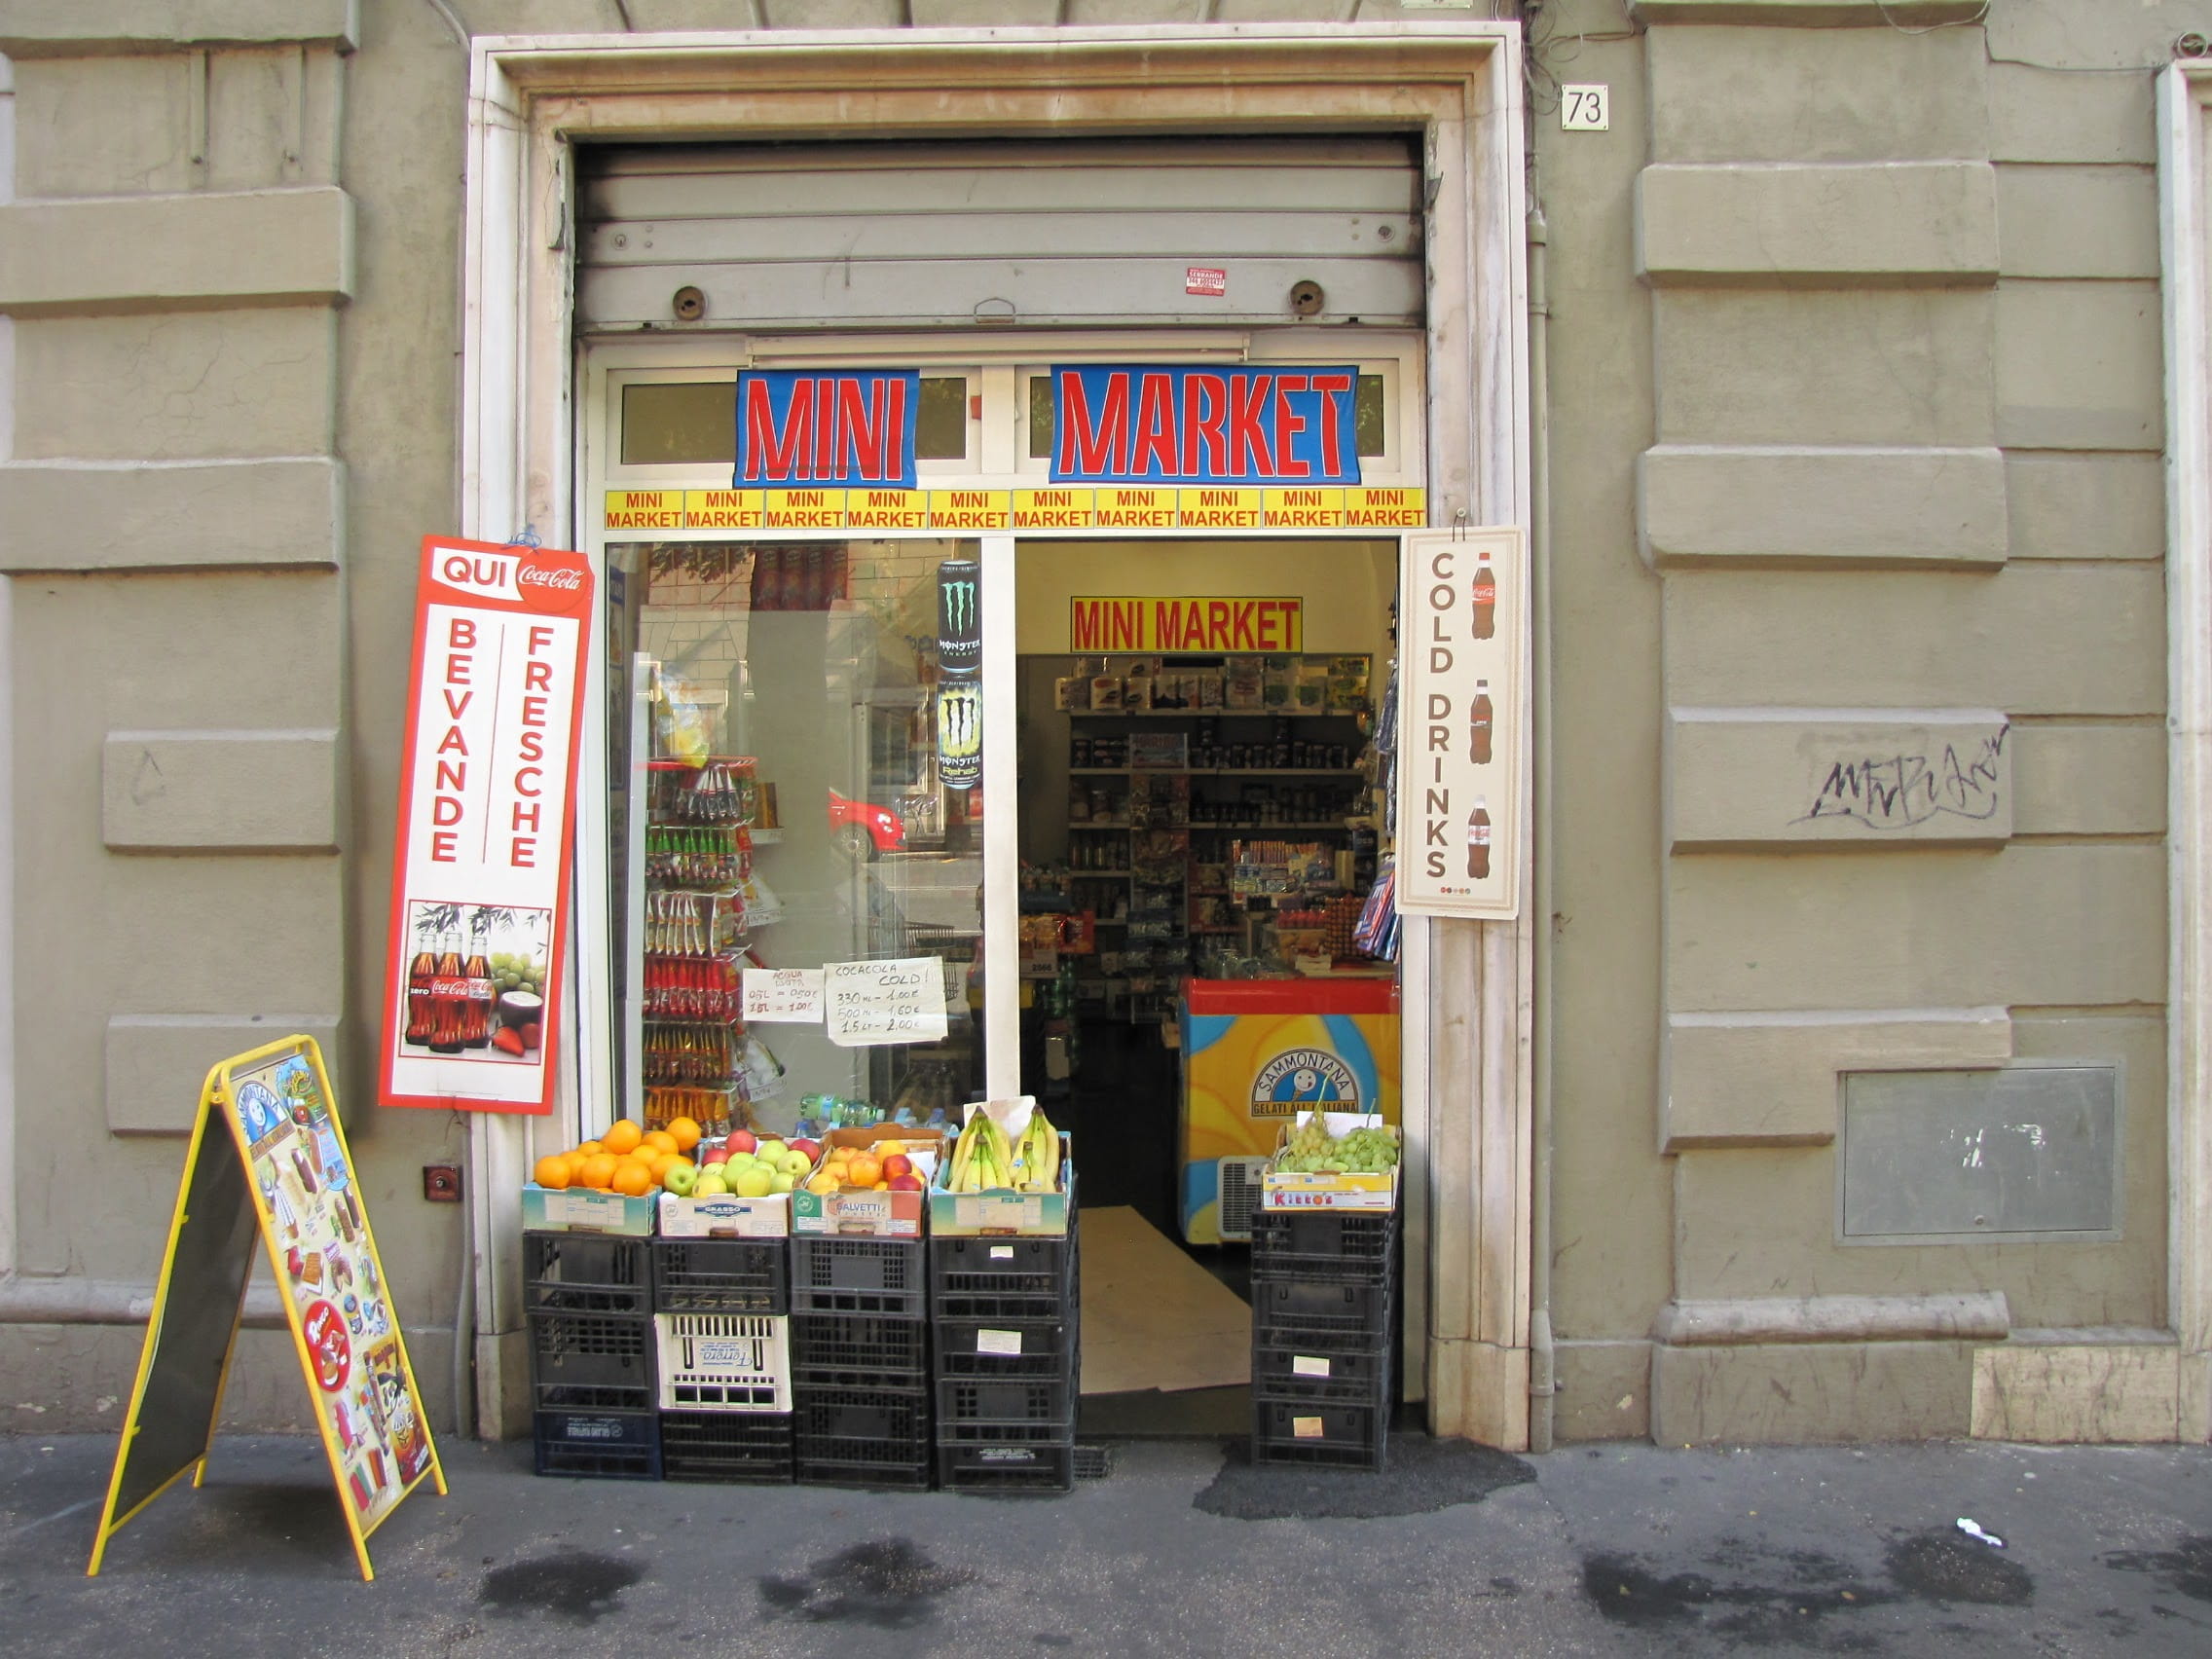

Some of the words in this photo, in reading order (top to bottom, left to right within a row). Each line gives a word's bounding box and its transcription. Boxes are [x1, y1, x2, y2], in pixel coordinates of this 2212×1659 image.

[1568, 92, 1601, 123] 73
[744, 378, 906, 482] MINI
[1057, 371, 1350, 478] MARKET
[626, 492, 662, 507] MINI
[706, 491, 743, 507] MINI
[787, 491, 825, 507] MINI
[867, 492, 906, 507] MINI
[950, 492, 989, 507] MINI
[1034, 490, 1072, 506] MINI
[1117, 490, 1155, 506] MINI
[1199, 490, 1238, 506] MINI
[1283, 490, 1322, 506] MINI
[1365, 490, 1404, 506] MINI
[607, 511, 682, 528] MARKET
[686, 510, 762, 527] MARKET
[766, 510, 844, 527] MARKET
[847, 511, 926, 528] MARKET
[929, 511, 1009, 529] MARKET
[1014, 510, 1091, 527] MARKET
[1097, 510, 1175, 527] MARKET
[1180, 510, 1259, 527] MARKET
[1264, 510, 1343, 527] MARKET
[1346, 509, 1424, 527] MARKET
[444, 555, 507, 587] QUI
[518, 564, 584, 592] Coca-Cola
[1429, 552, 1456, 674] COLD
[1074, 600, 1144, 649] MINI
[1155, 600, 1300, 649] MARKET
[939, 639, 980, 651] MONSTER
[431, 617, 477, 863] BEVANDE
[510, 625, 555, 868] FRESCHE
[939, 755, 980, 766] MONSTER
[942, 765, 978, 776] Rehab
[1425, 694, 1452, 878] DRINKS
[835, 964, 897, 977] COCACOLA
[410, 987, 430, 996] zero
[837, 992, 861, 1007] 330
[837, 1008, 861, 1020] 500
[1258, 1052, 1350, 1092] SAMMONTANA
[1254, 1104, 1287, 1115] GELATI
